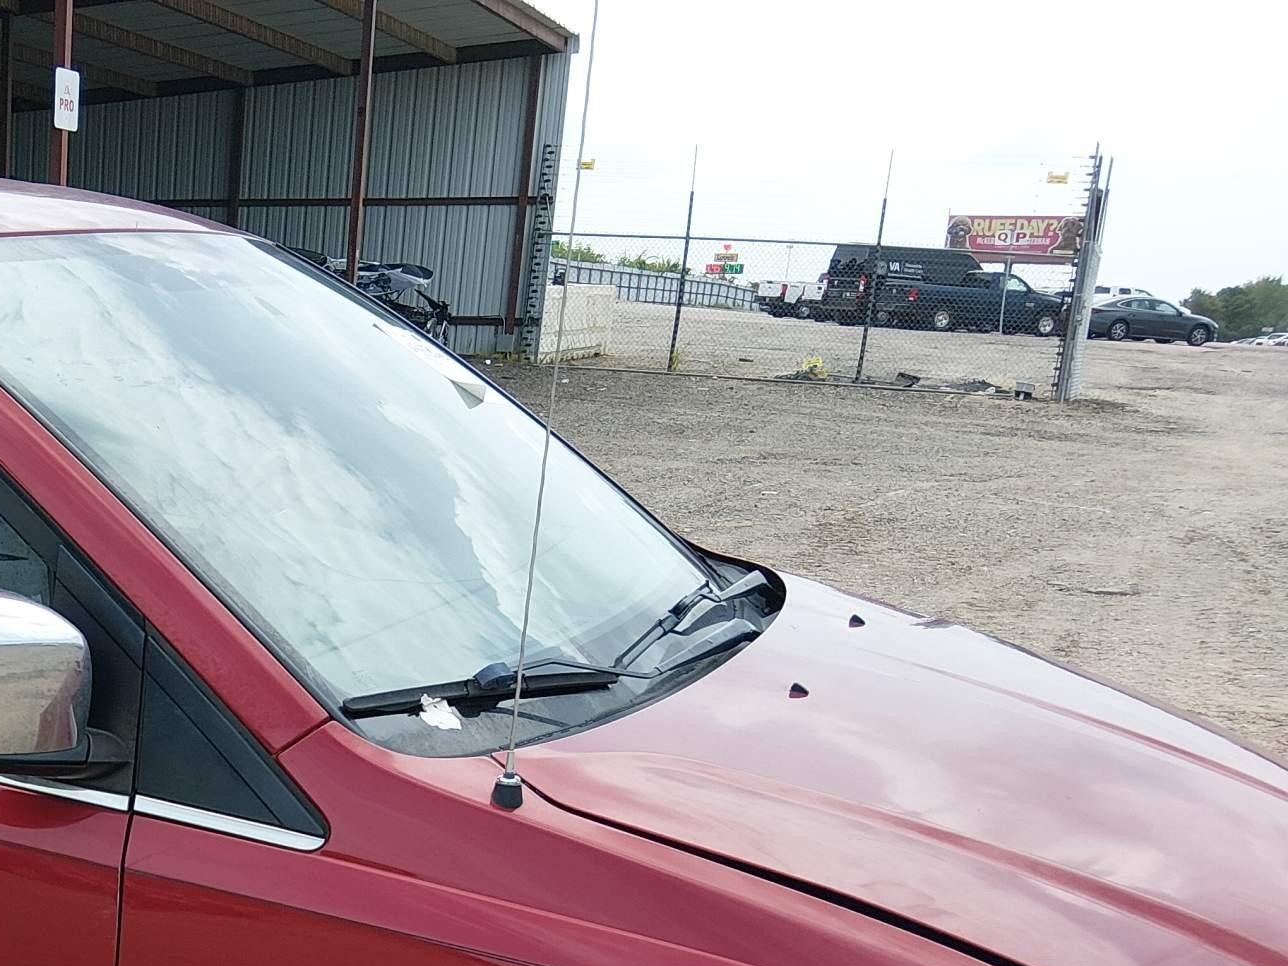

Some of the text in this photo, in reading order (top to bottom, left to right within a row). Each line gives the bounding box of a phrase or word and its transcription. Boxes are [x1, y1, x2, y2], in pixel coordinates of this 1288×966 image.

[59, 97, 75, 113] PRO
[998, 232, 1008, 243] Q
[1015, 232, 1027, 243] P
[889, 261, 900, 272] VA
